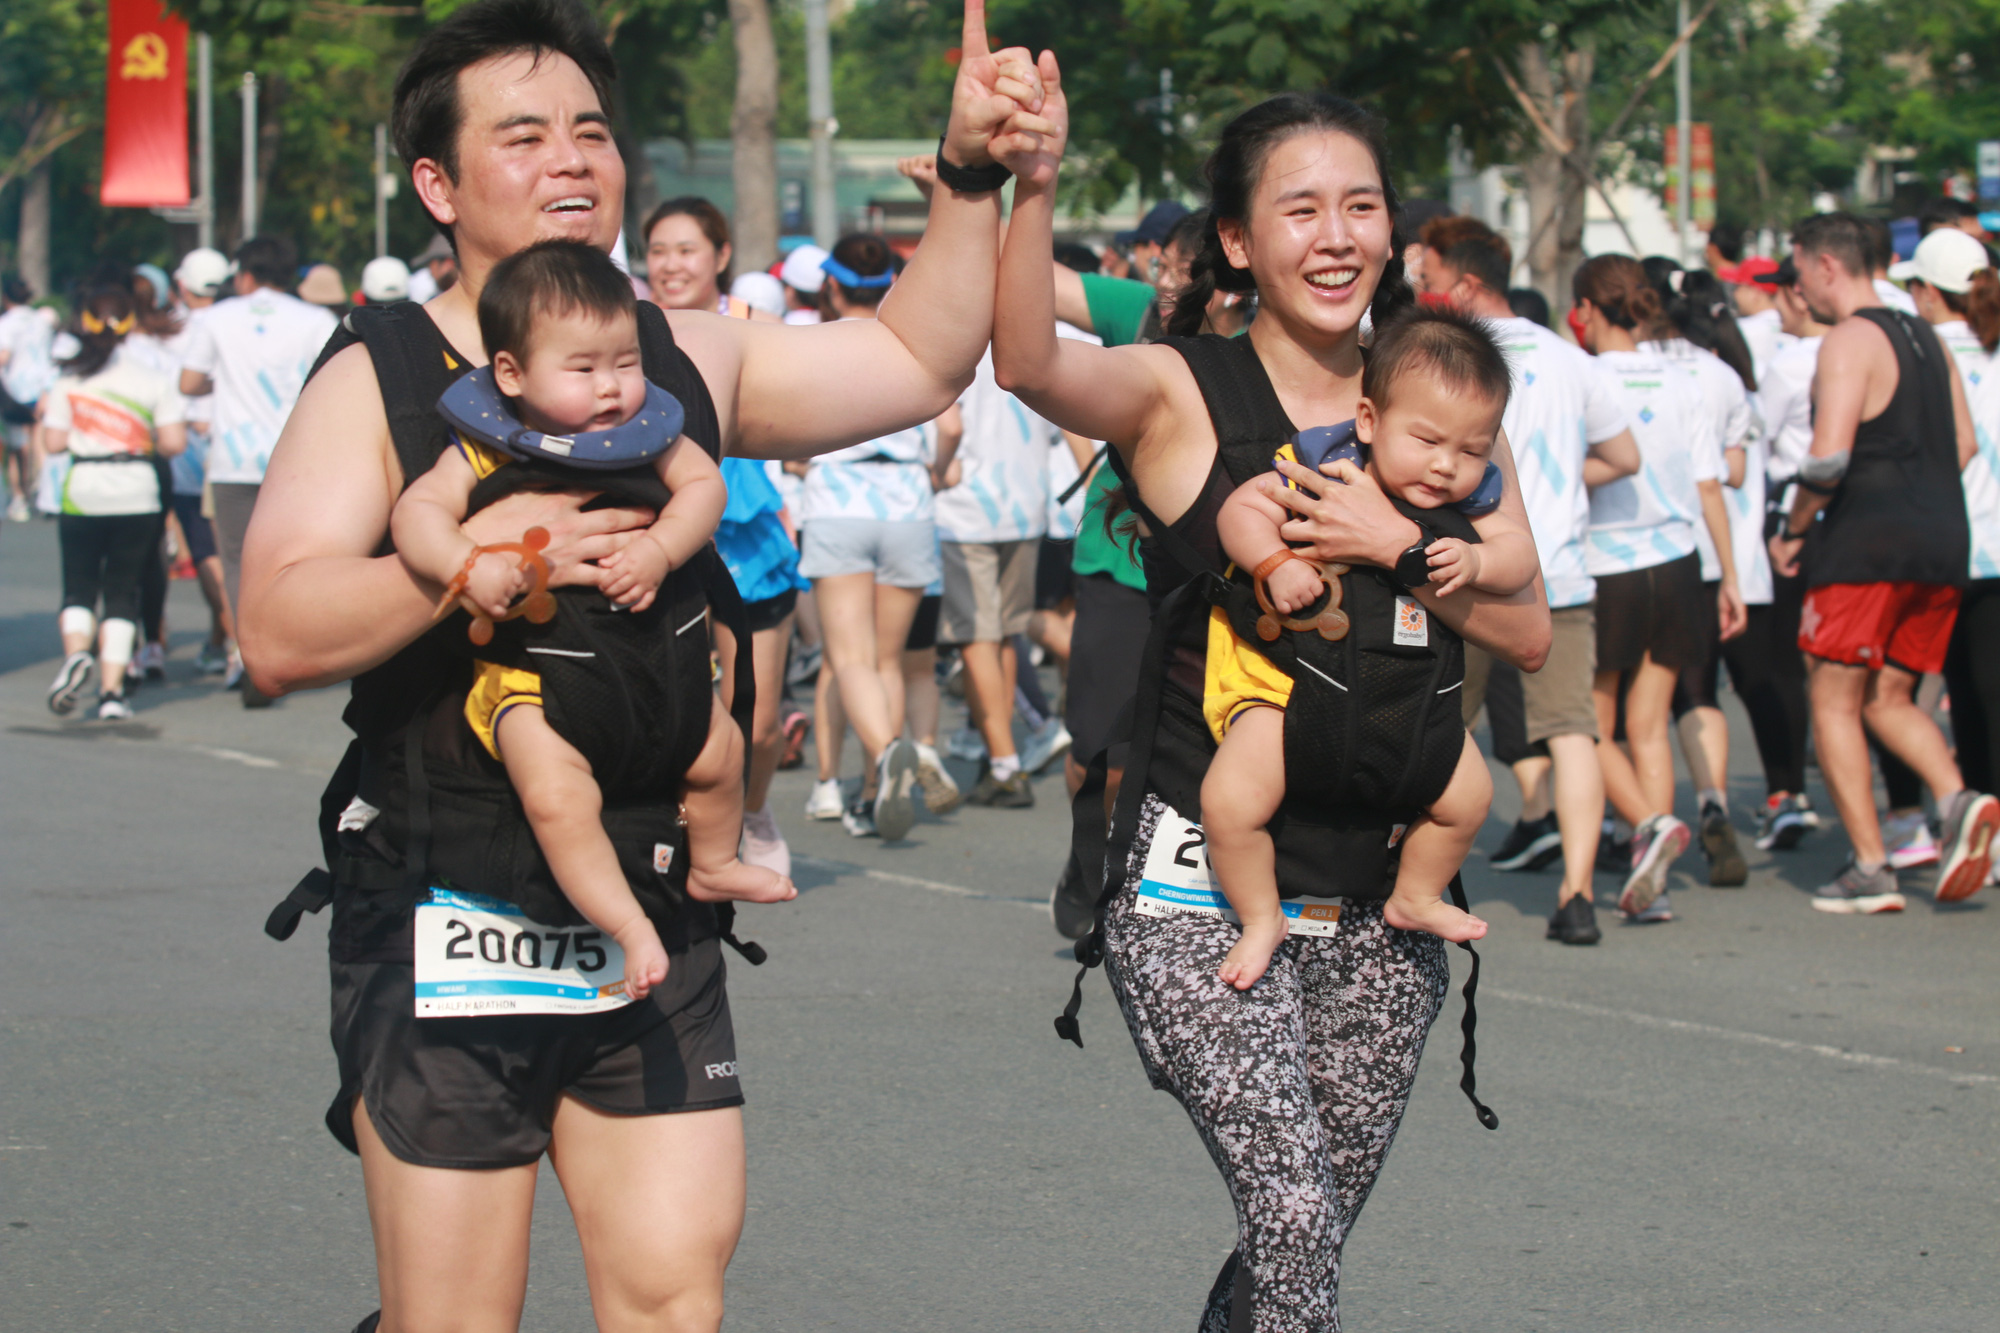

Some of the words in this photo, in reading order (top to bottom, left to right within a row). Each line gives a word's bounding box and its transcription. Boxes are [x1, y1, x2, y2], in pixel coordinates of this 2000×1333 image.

[1397, 632, 1422, 640] ergobaby
[1173, 827, 1212, 871] 2
[1154, 903, 1178, 915] HALF
[1310, 908, 1327, 917] PEN
[1327, 909, 1333, 918] 1
[445, 919, 607, 972] 20075
[437, 1001, 461, 1010] HALF
[464, 1000, 516, 1010] MARATHON
